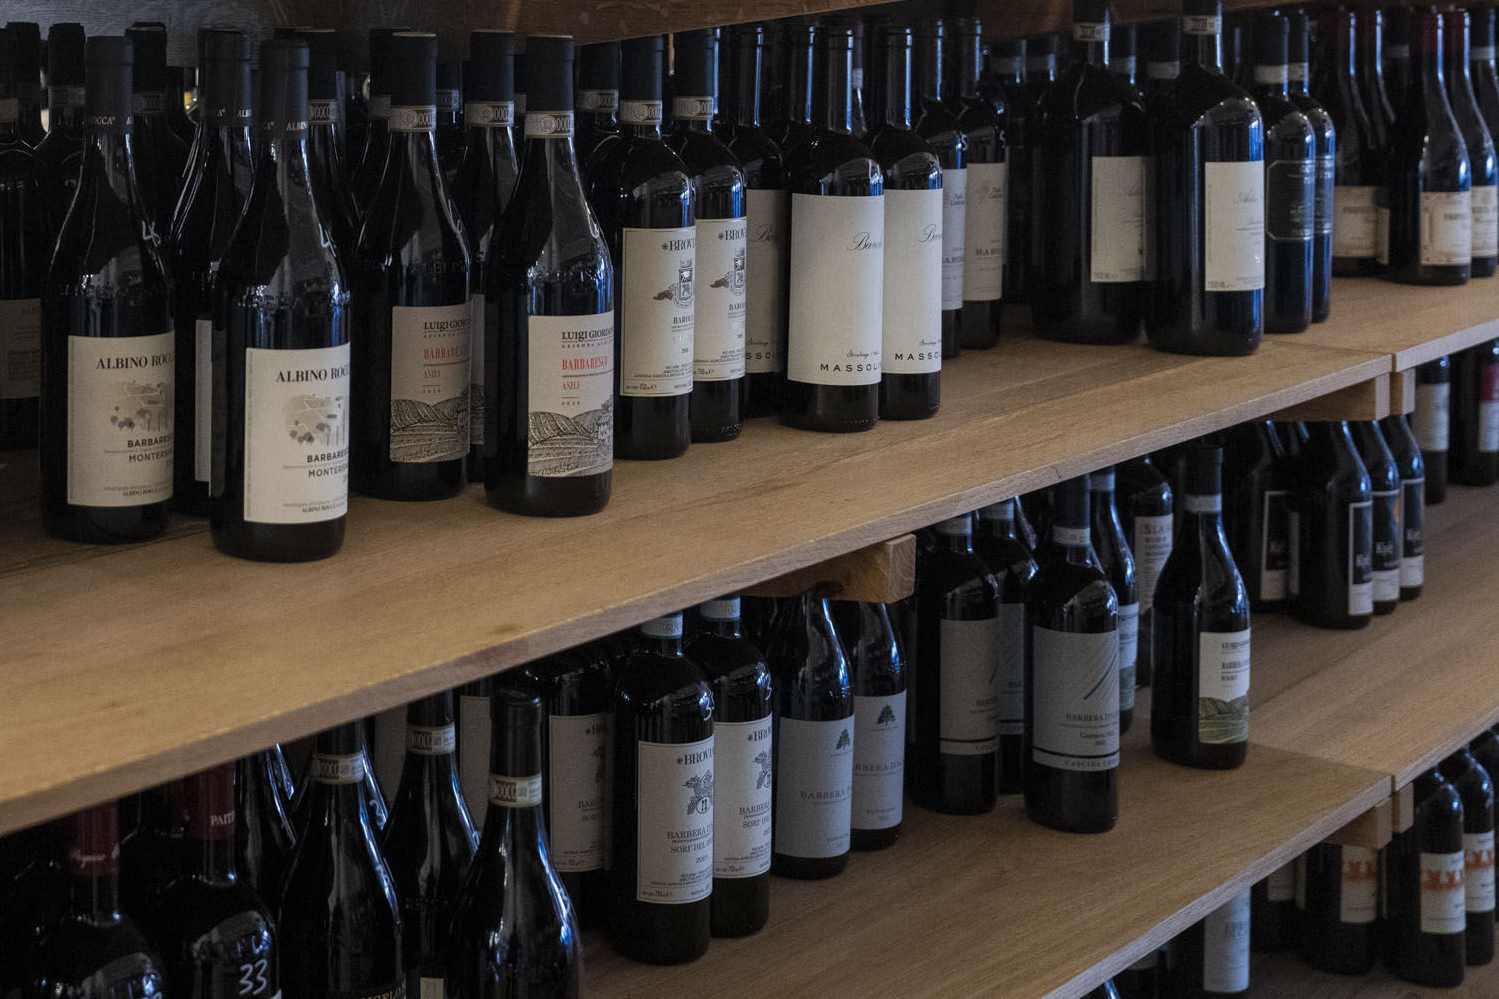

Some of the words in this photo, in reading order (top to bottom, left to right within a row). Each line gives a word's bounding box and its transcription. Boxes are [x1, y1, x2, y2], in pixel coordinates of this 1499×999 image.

[96, 355, 148, 369] ALBINO
[562, 355, 608, 370] BARBARESCO
[820, 363, 881, 372] MASSOLI
[276, 368, 327, 383] ALBINO
[307, 448, 349, 463] BARBARES
[1066, 712, 1104, 722] BARBERA
[800, 790, 845, 800] BARBERA
[667, 828, 706, 839] BARBERA
[239, 958, 269, 995] 33
